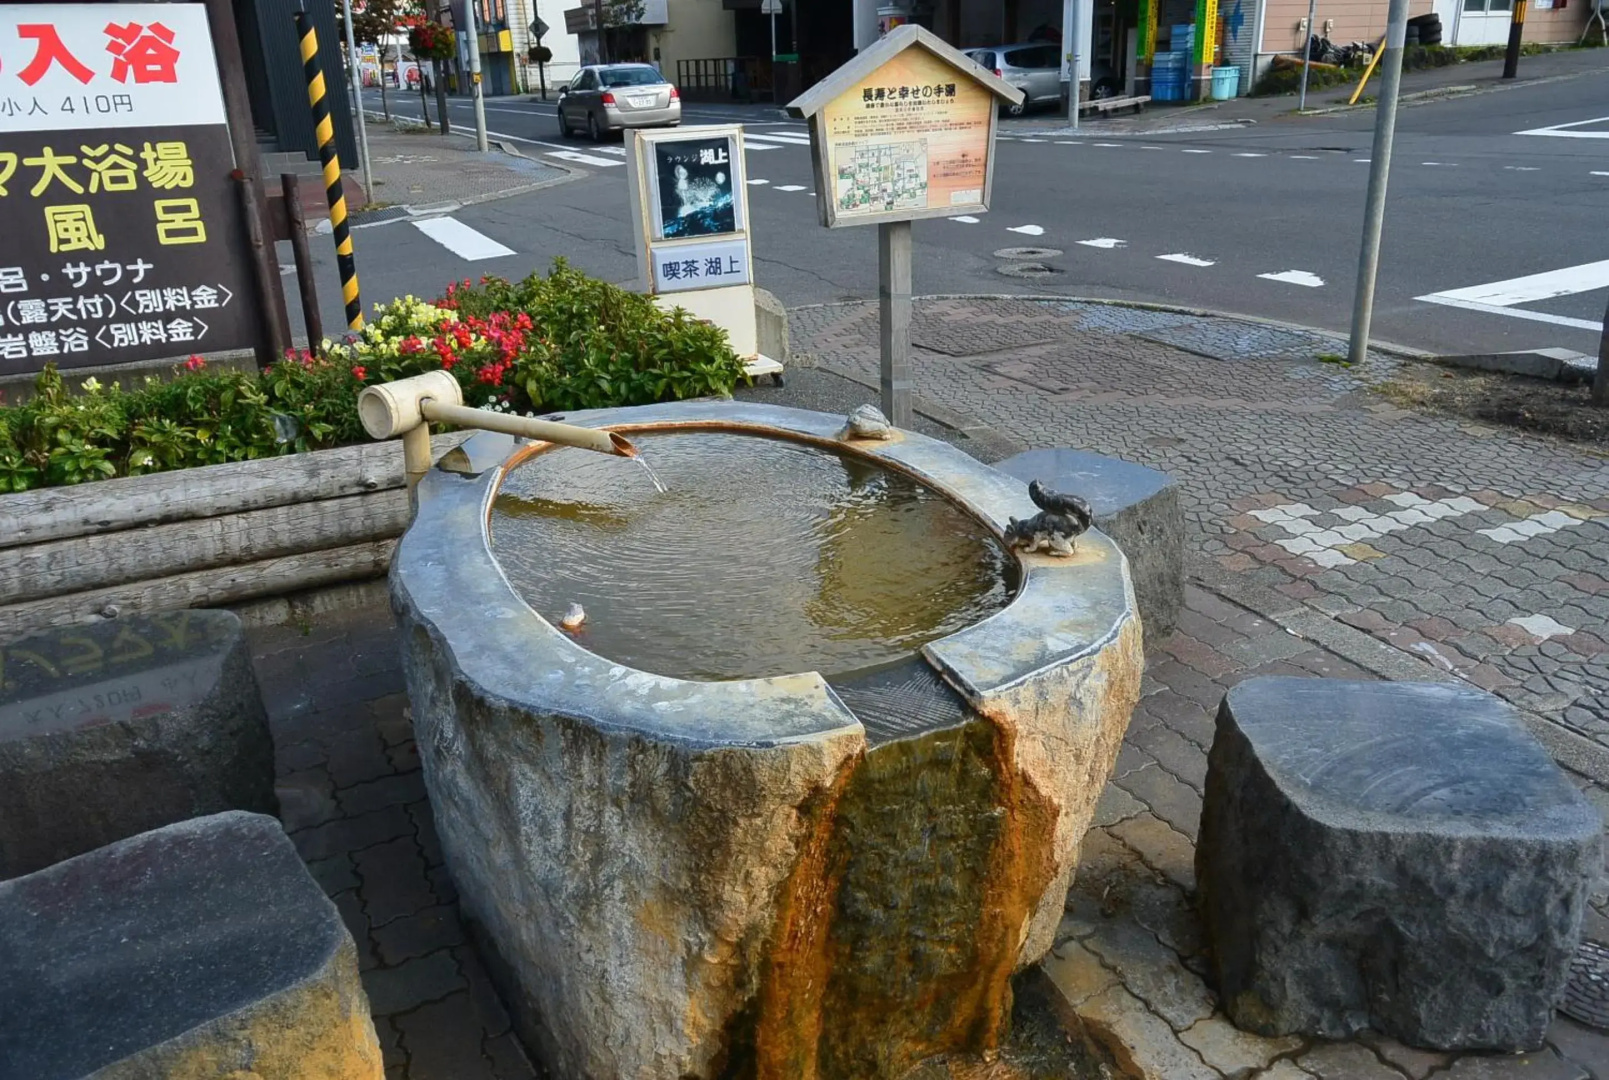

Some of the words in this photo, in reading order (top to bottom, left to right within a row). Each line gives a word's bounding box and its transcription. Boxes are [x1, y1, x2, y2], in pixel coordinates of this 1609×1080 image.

[0, 21, 182, 87] 入浴
[60, 94, 134, 115] 410円
[700, 148, 729, 166] 湖上
[662, 259, 700, 281] 喫茶
[704, 255, 742, 278] 湖上
